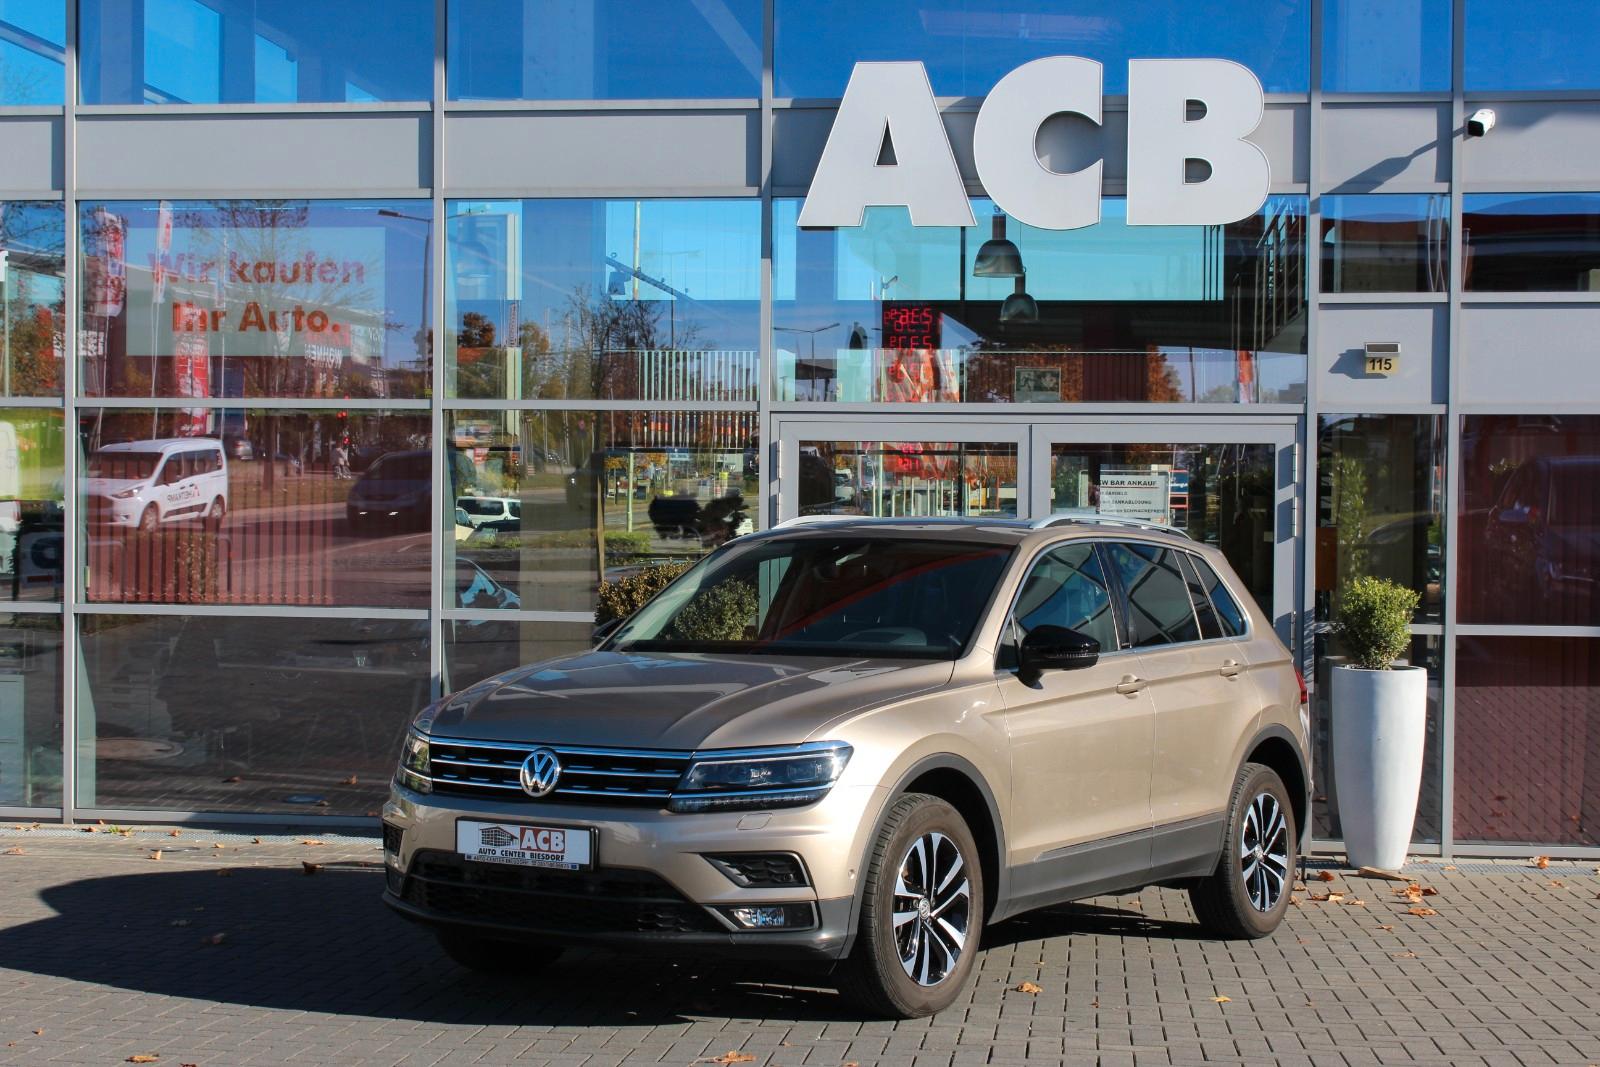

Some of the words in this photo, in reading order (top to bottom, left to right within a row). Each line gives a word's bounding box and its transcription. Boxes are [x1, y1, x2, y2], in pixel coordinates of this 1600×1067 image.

[797, 55, 1271, 231] ACB
[148, 251, 216, 284] Wir
[229, 251, 365, 284] kaufen
[172, 301, 226, 332] Ihr
[239, 301, 341, 332] Auto.
[1369, 358, 1392, 370] 115
[521, 829, 565, 852] ACB
[478, 847, 497, 856] AUTO
[500, 850, 526, 859] CENTER
[530, 852, 565, 862] BIESDORF
